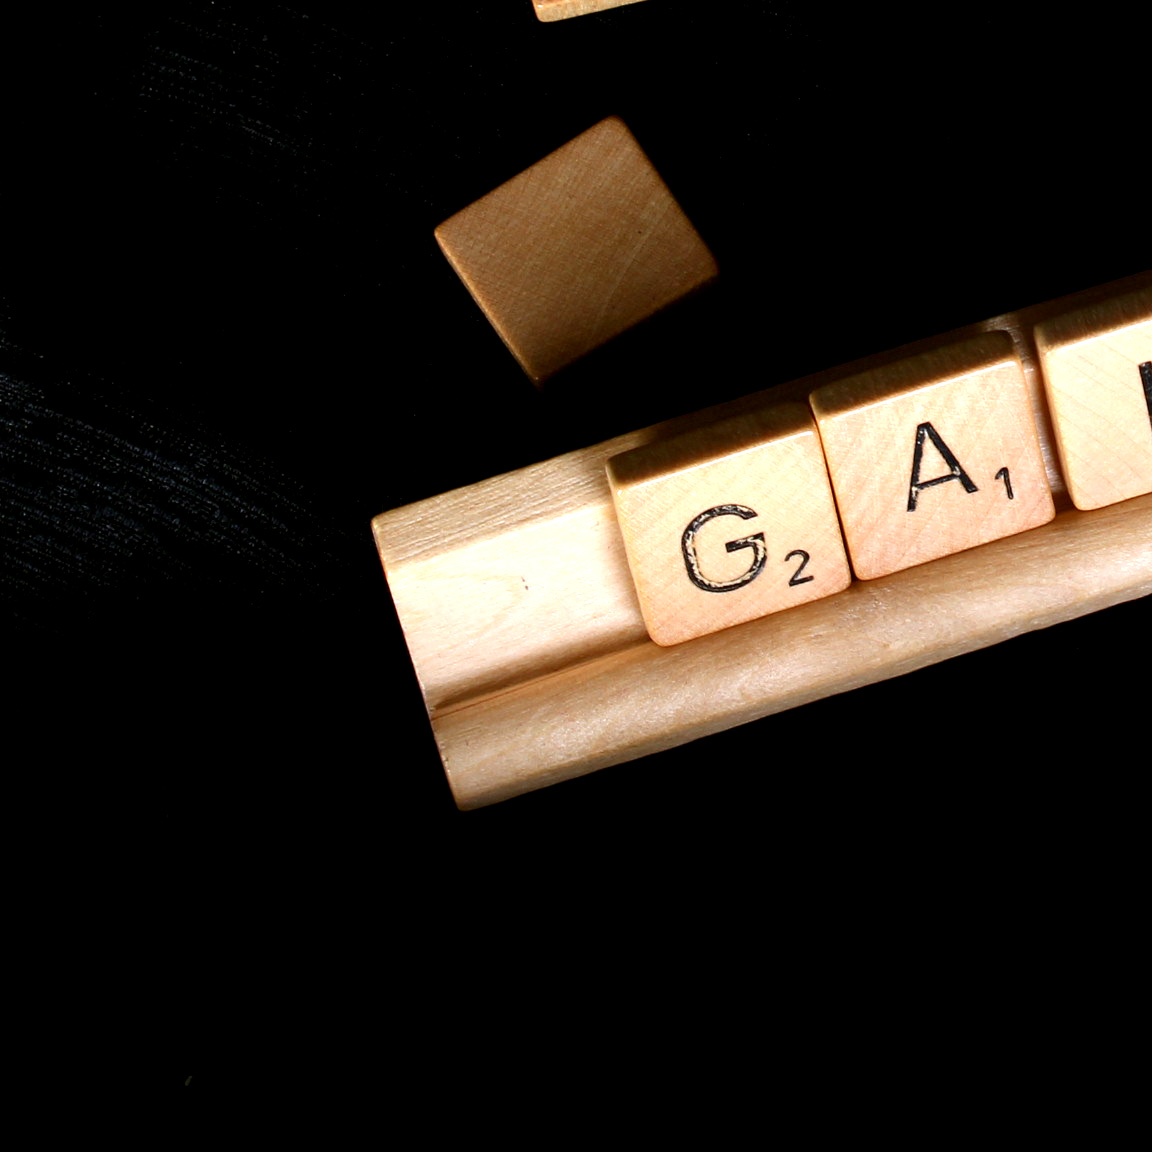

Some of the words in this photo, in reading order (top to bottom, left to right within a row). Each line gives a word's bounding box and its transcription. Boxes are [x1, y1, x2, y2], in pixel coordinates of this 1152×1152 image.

[906, 421, 980, 513] A
[994, 466, 1014, 500] 1
[680, 503, 768, 594] G
[784, 549, 815, 588] 2
